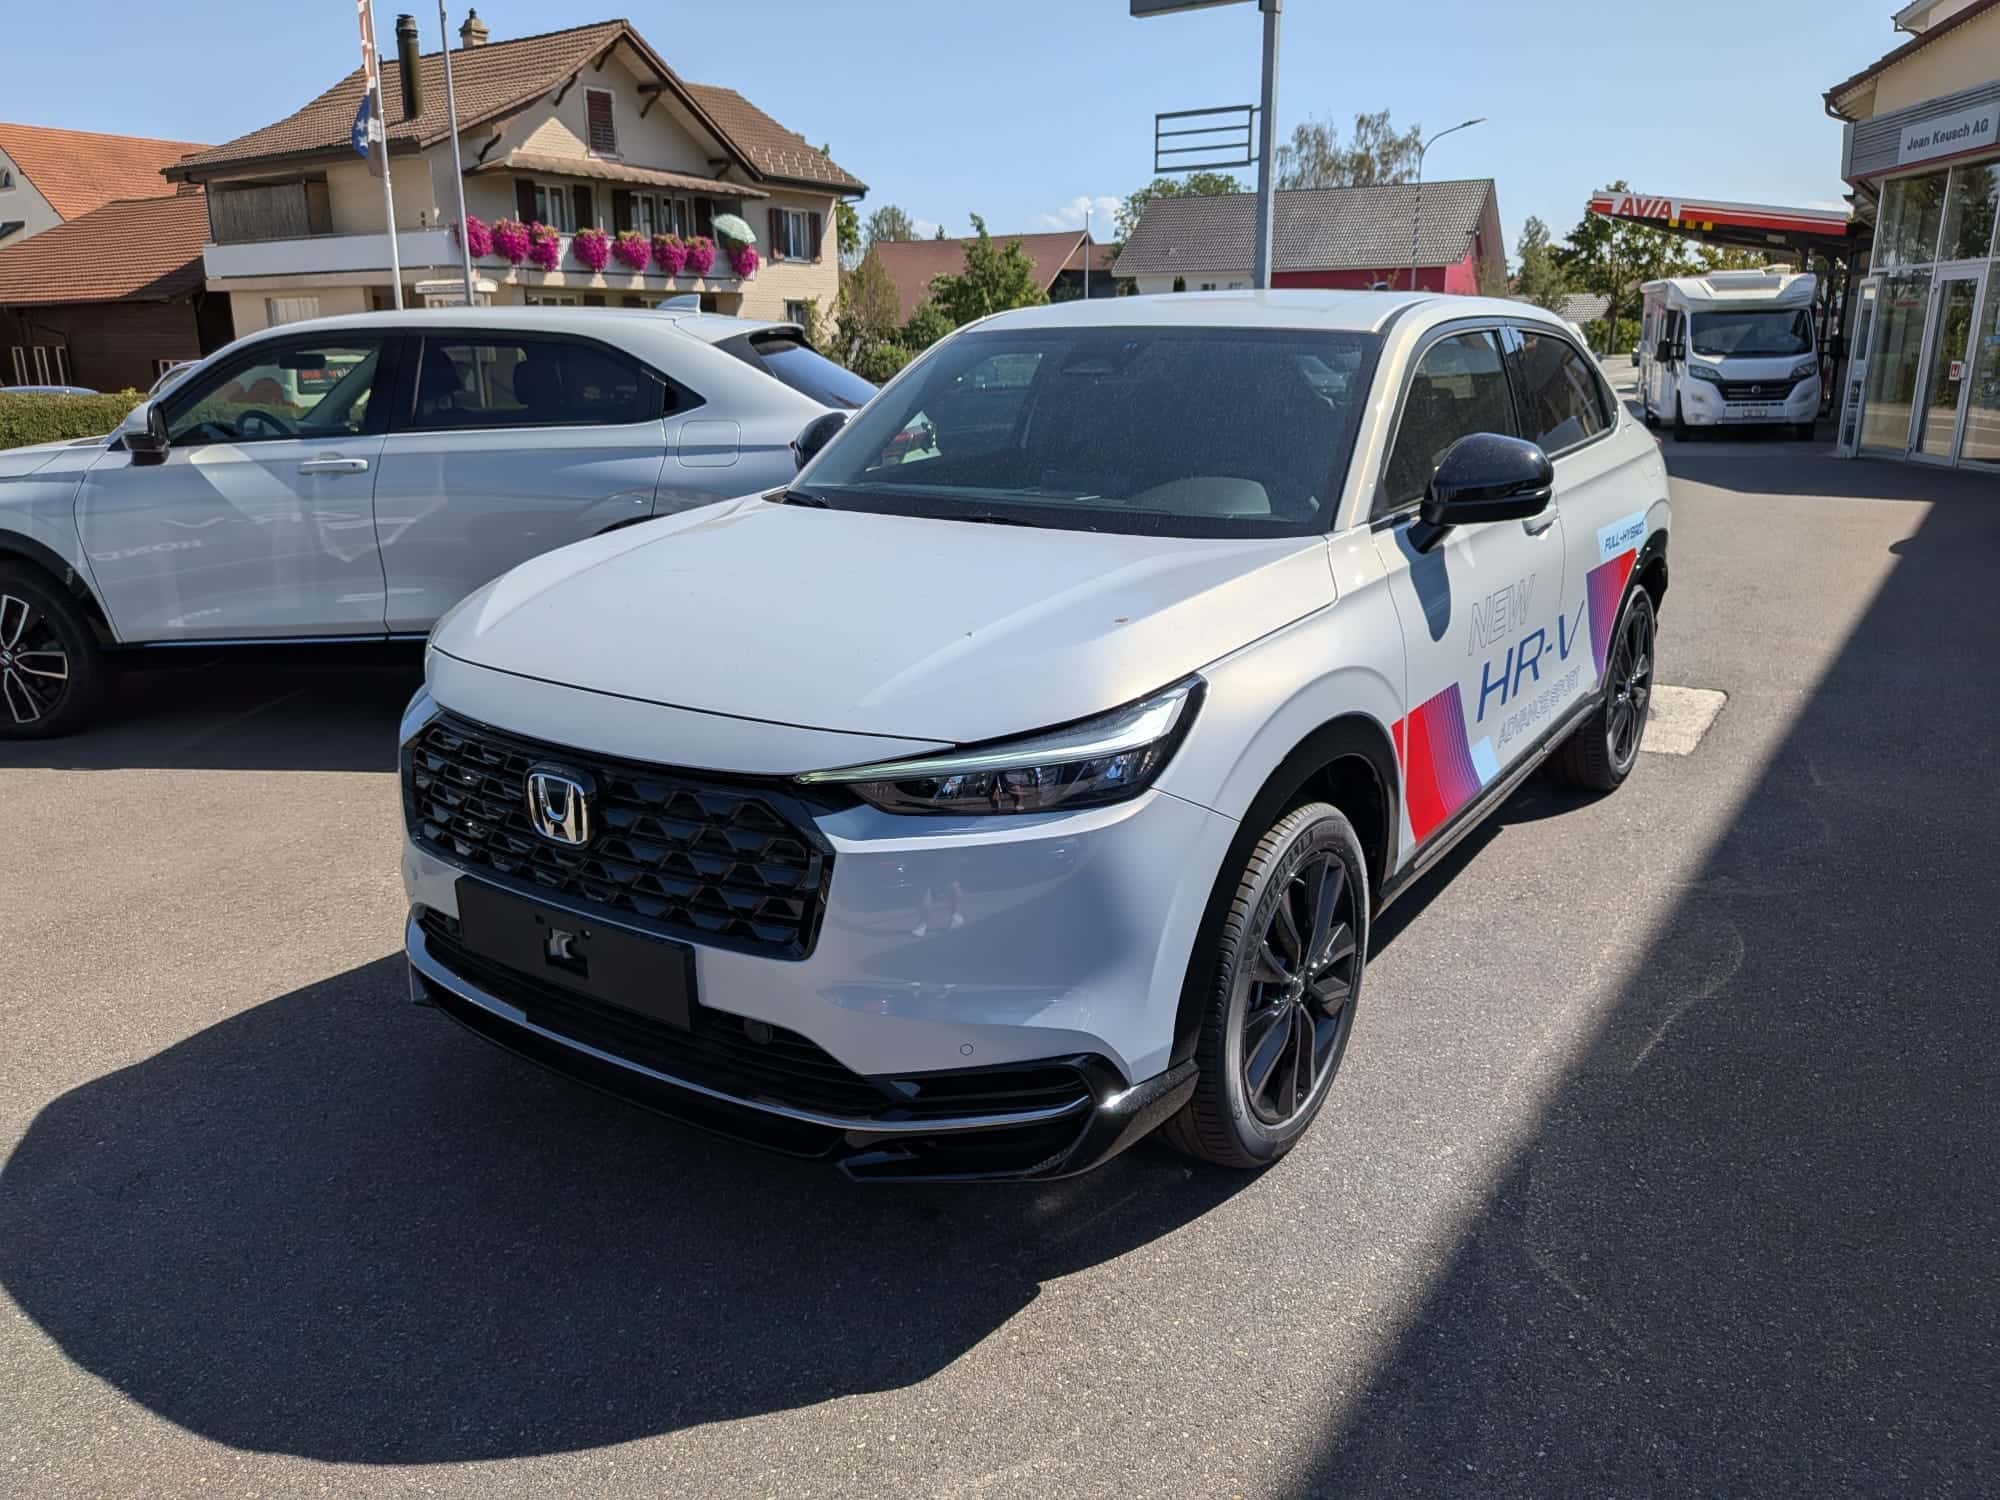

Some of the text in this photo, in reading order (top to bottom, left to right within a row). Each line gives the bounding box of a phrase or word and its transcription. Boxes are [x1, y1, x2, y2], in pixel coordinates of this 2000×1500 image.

[1907, 118, 1989, 151] Jean Keusch AG
[1619, 197, 1673, 219] AVIA
[1468, 573, 1536, 656] NEW
[1477, 600, 1585, 722] HR-V
